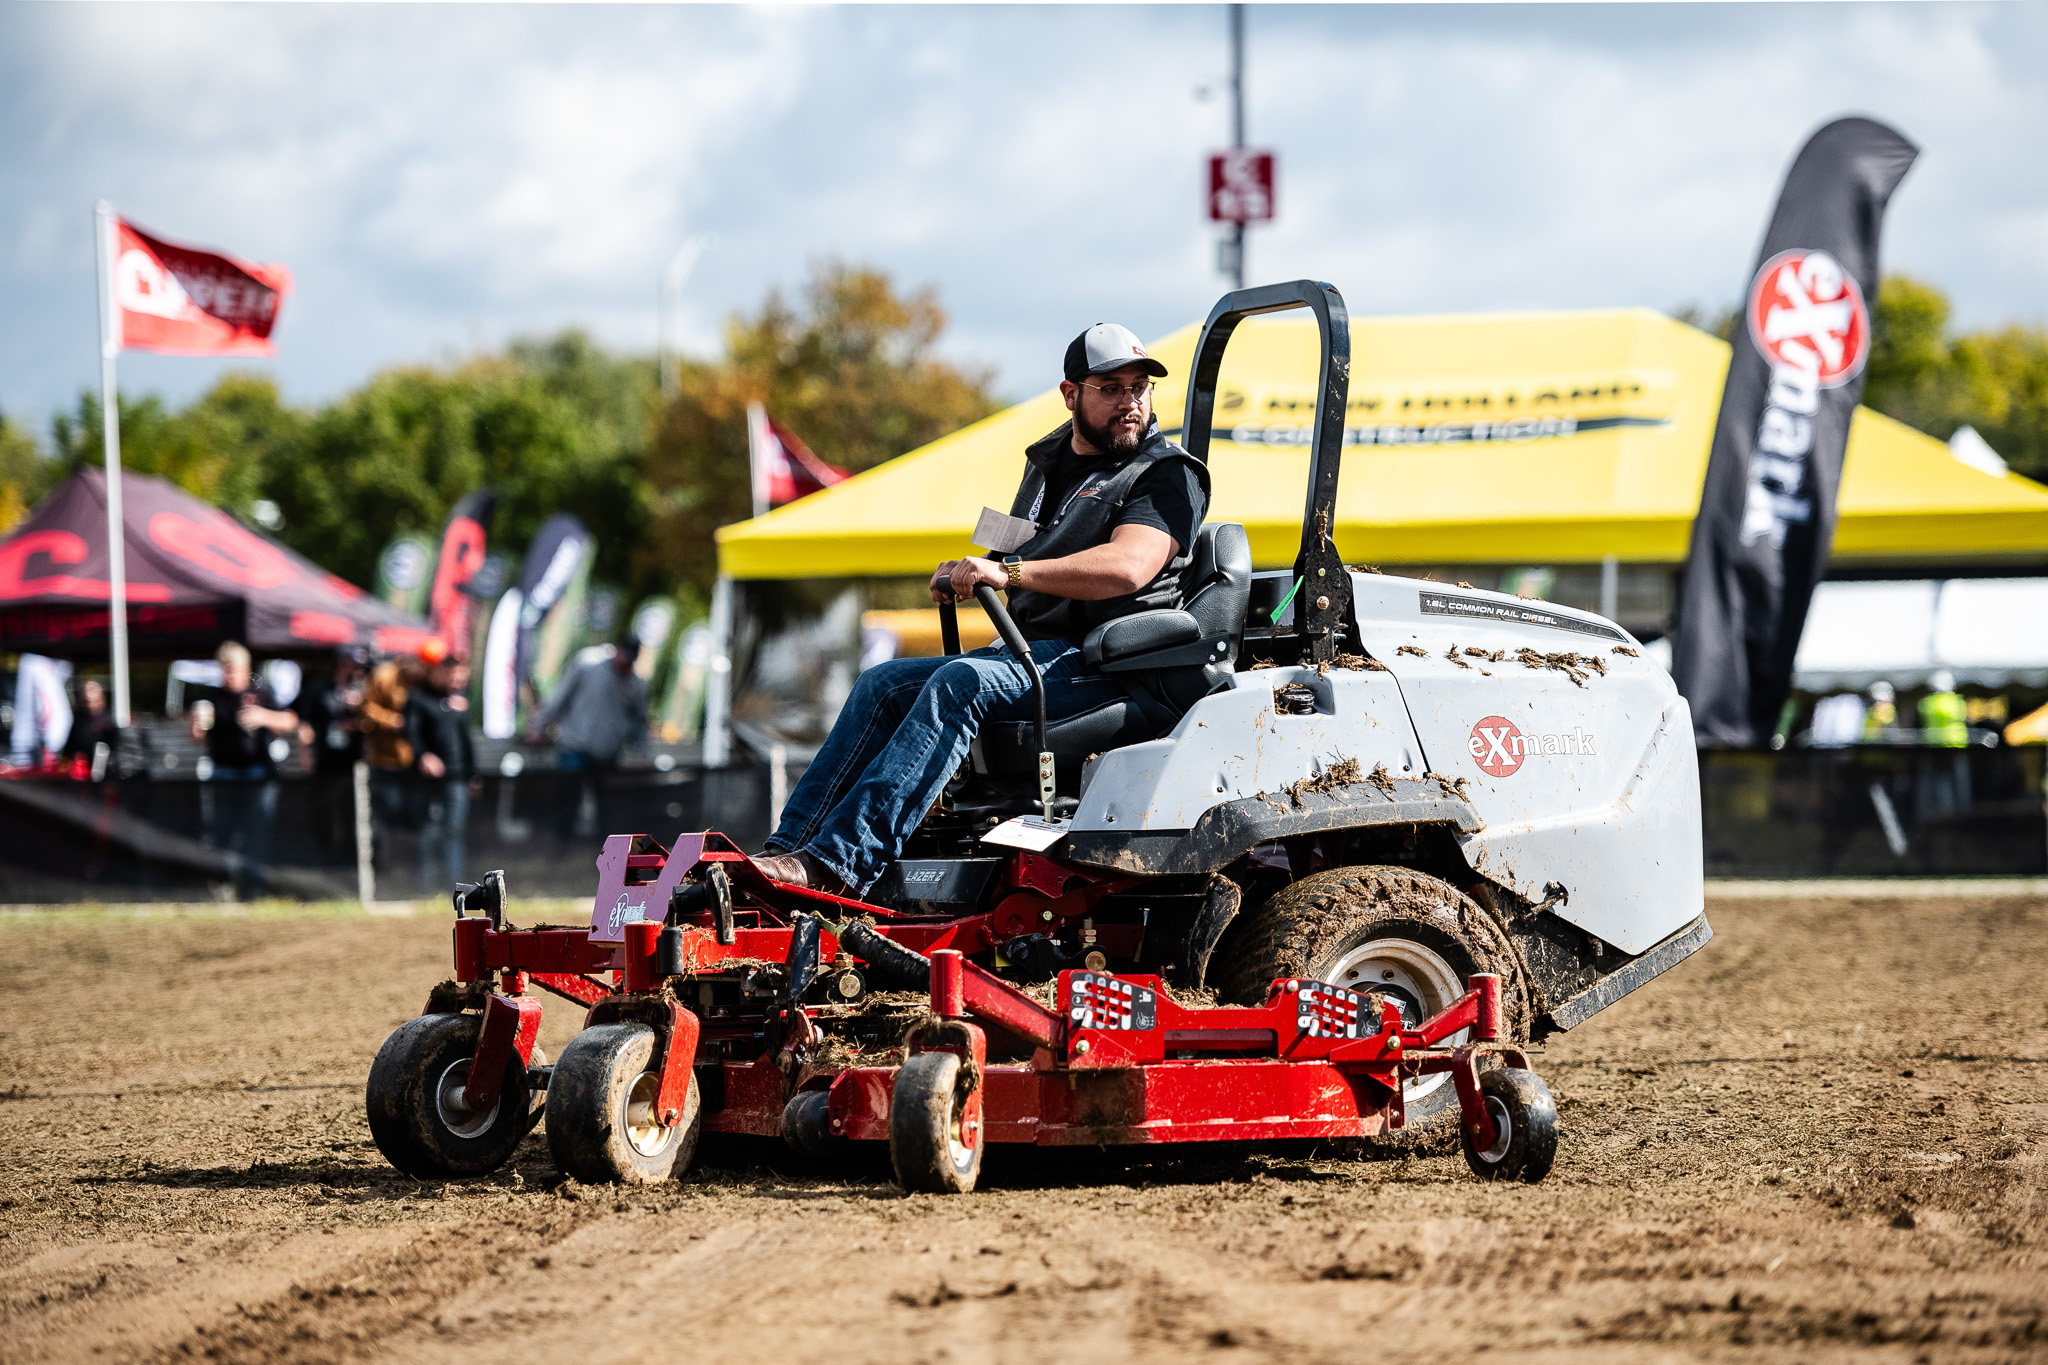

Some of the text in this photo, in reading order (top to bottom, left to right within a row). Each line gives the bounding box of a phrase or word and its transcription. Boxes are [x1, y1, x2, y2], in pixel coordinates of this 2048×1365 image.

[1739, 252, 1853, 548] eXmark
[1448, 602, 1495, 614] COMMON
[1495, 608, 1520, 618] RAIL
[1521, 612, 1558, 625] DIESEL
[1468, 726, 1597, 767] eXmark
[904, 869, 936, 882] LAZER
